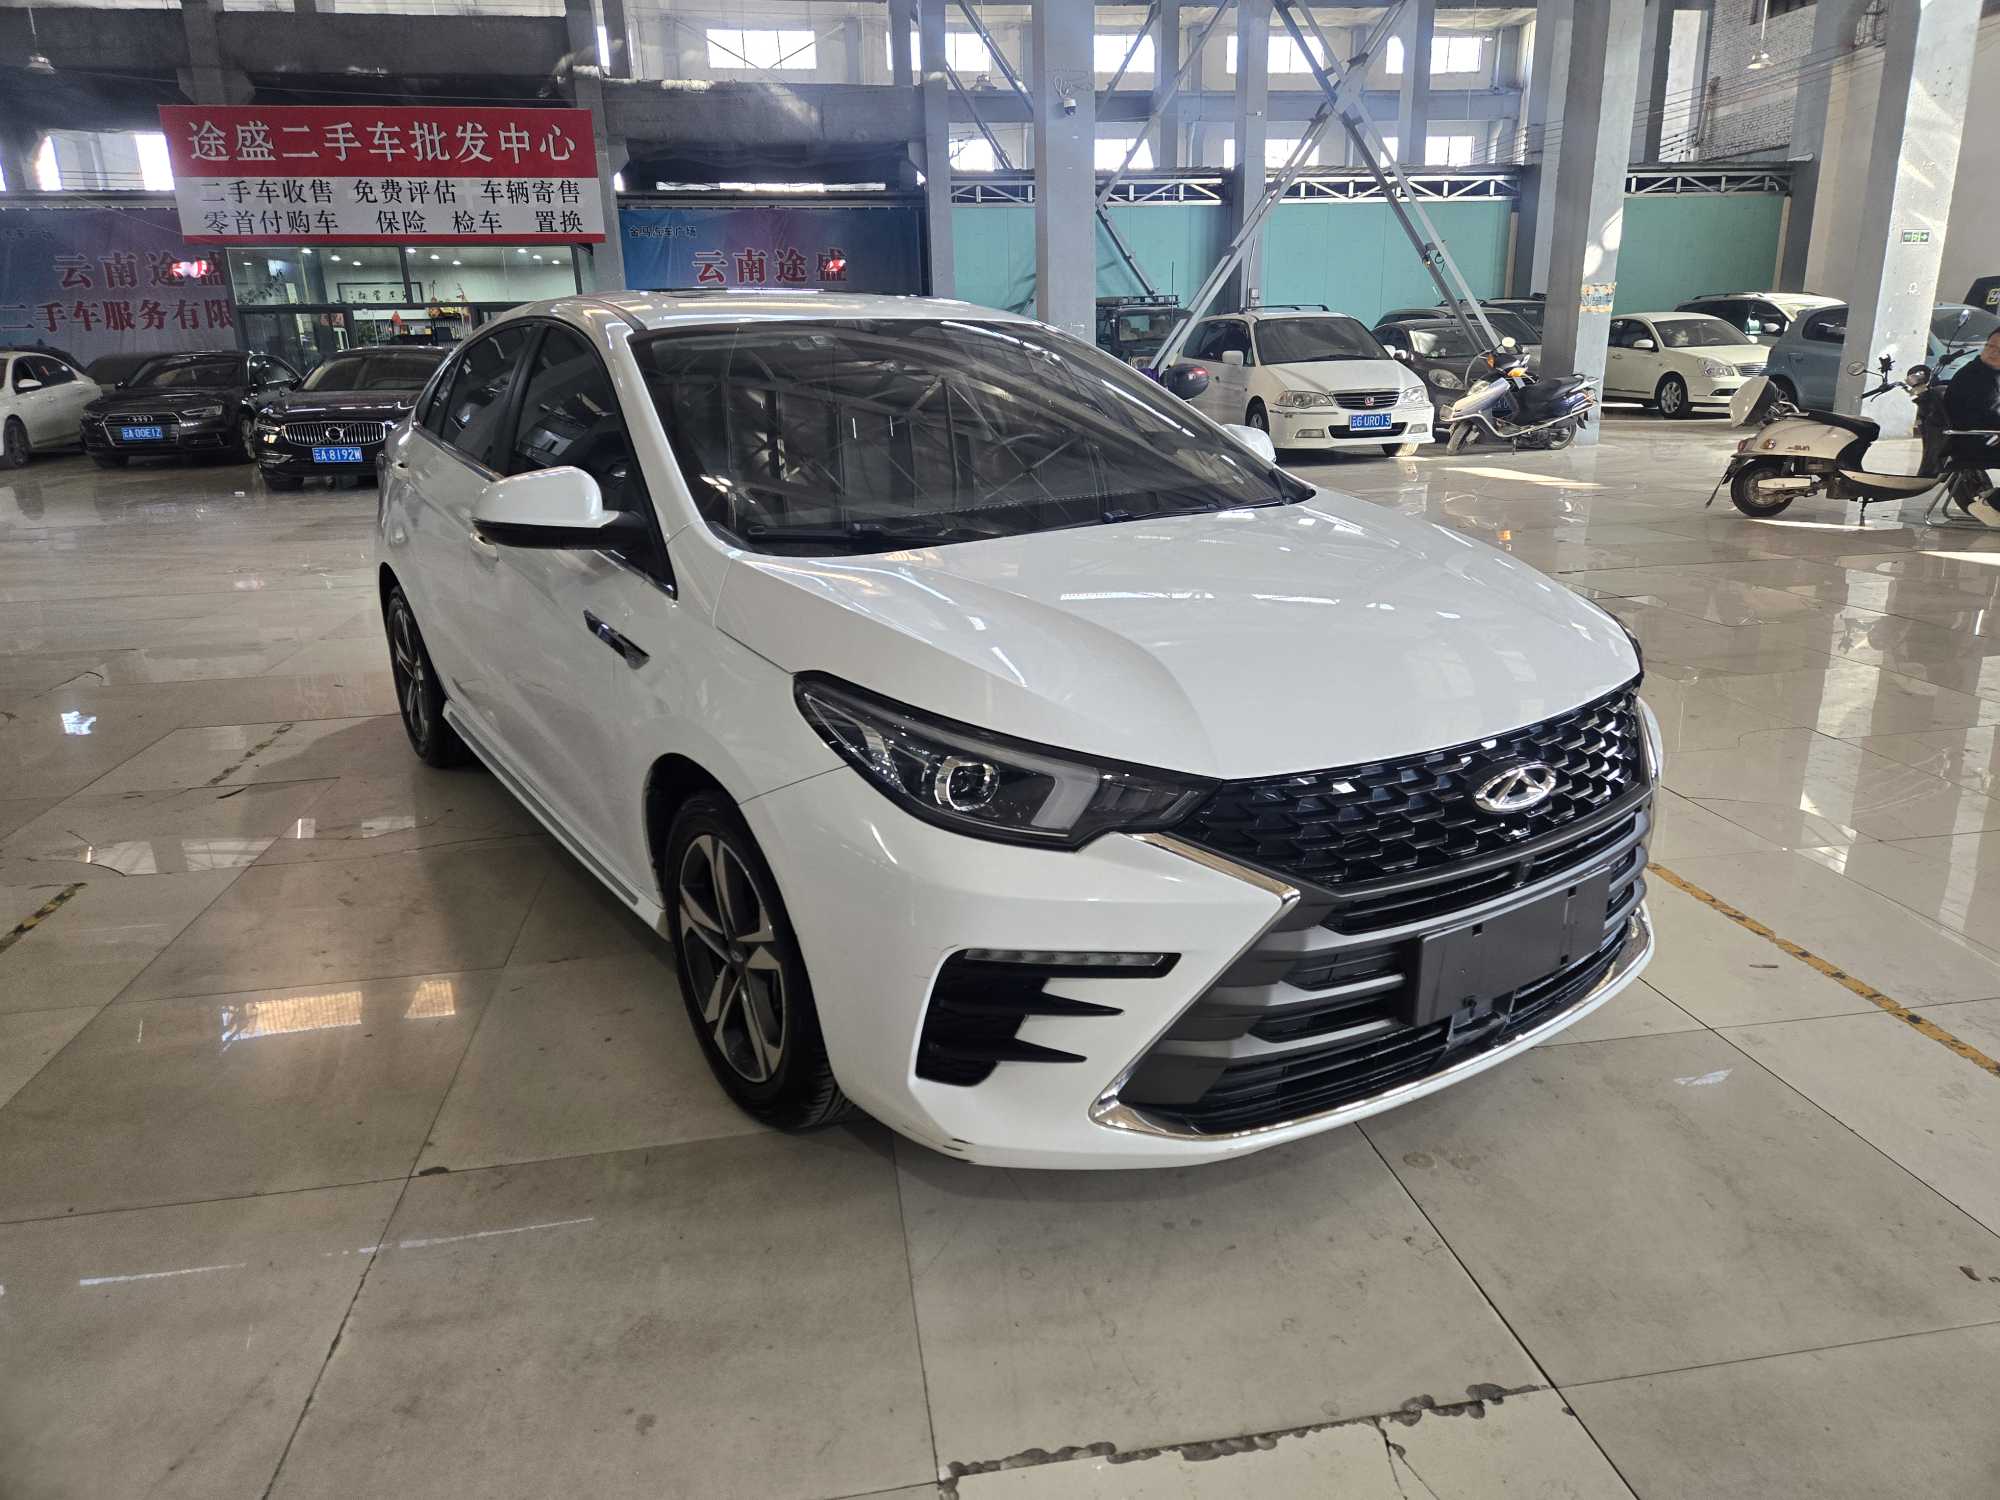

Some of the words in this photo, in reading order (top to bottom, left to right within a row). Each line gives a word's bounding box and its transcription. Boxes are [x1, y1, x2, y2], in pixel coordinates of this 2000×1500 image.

[187, 119, 577, 164] 途盛二手车批发中心
[200, 179, 334, 204] 二手车收售
[352, 179, 457, 205] 免费评估
[480, 179, 581, 205] 车辆寄售
[203, 209, 339, 234] 零首付购车
[375, 209, 428, 234] 保险
[451, 209, 504, 234] 检车
[534, 209, 584, 234] 置换
[691, 247, 849, 285] 云南途盛
[0, 299, 234, 333] 二手车服务有限
